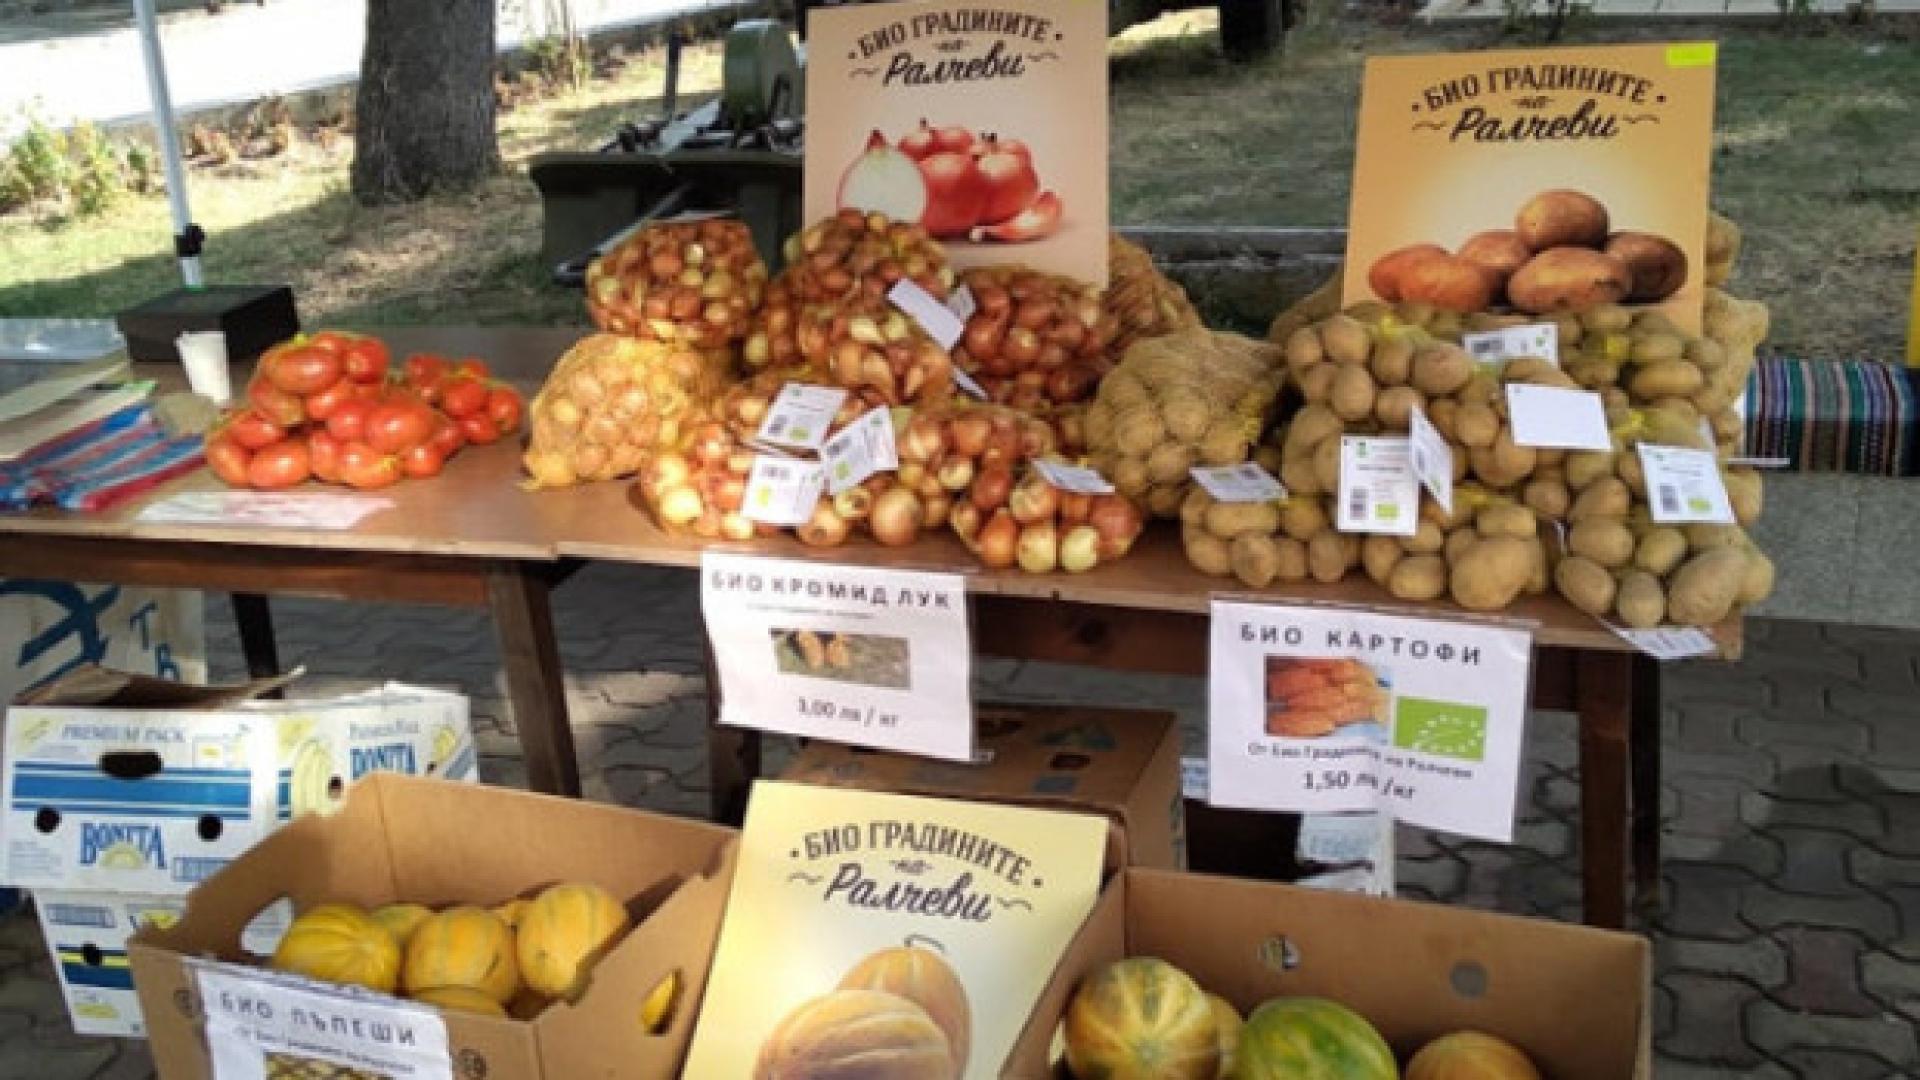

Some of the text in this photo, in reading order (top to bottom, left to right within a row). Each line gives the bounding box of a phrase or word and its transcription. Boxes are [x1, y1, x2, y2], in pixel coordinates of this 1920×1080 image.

[858, 9, 1053, 58] БИО ГРАДИНИТЕ
[883, 40, 1026, 86] Ралчеви
[1424, 65, 1654, 111] БИО ГРАДИНИТЕ
[1450, 99, 1620, 142] Ралчеви
[711, 570, 951, 609] БИО КРОМИД ЛУК
[1241, 622, 1481, 665] БИО КАРТОФИ
[62, 723, 140, 742] PREMIUM
[145, 725, 187, 743] PACK
[1304, 769, 1349, 792] 1,50
[79, 822, 168, 870] BONITA
[804, 819, 1032, 886] БИО ГРАДИНИТЕ
[824, 861, 992, 922] Ралчеви
[220, 991, 274, 1020] БИО
[290, 1007, 416, 1046] ПЪПЕШИ
